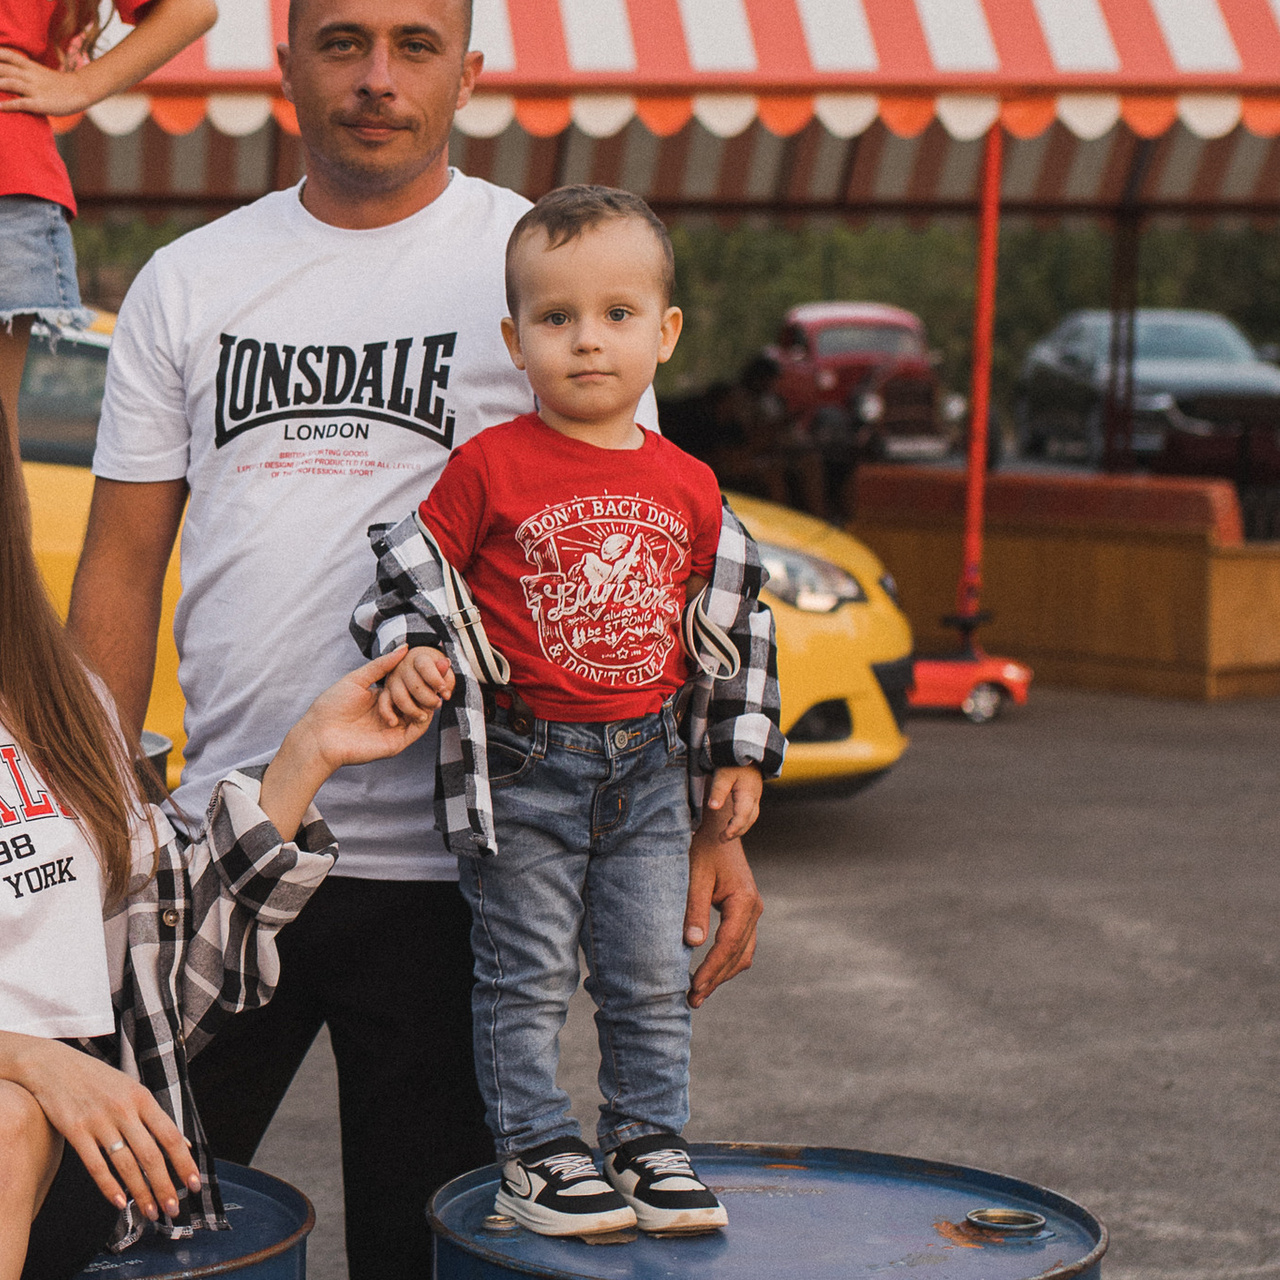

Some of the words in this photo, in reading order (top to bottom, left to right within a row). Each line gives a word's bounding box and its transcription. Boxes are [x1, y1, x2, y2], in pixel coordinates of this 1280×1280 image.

[215, 332, 458, 450] LONSDALE
[284, 423, 369, 441] LONDON
[297, 468, 346, 476] ROFESSIONAL
[349, 468, 373, 477] SPORT
[528, 503, 585, 537] DON'T
[592, 500, 641, 518] BACK
[646, 507, 689, 547] DOWN
[587, 626, 602, 637] be
[605, 610, 652, 633] STRONG
[549, 643, 564, 658] &
[562, 656, 620, 686] DON'T
[626, 657, 659, 684] GIVE
[656, 635, 672, 658] UP
[3, 856, 77, 899] YORK
